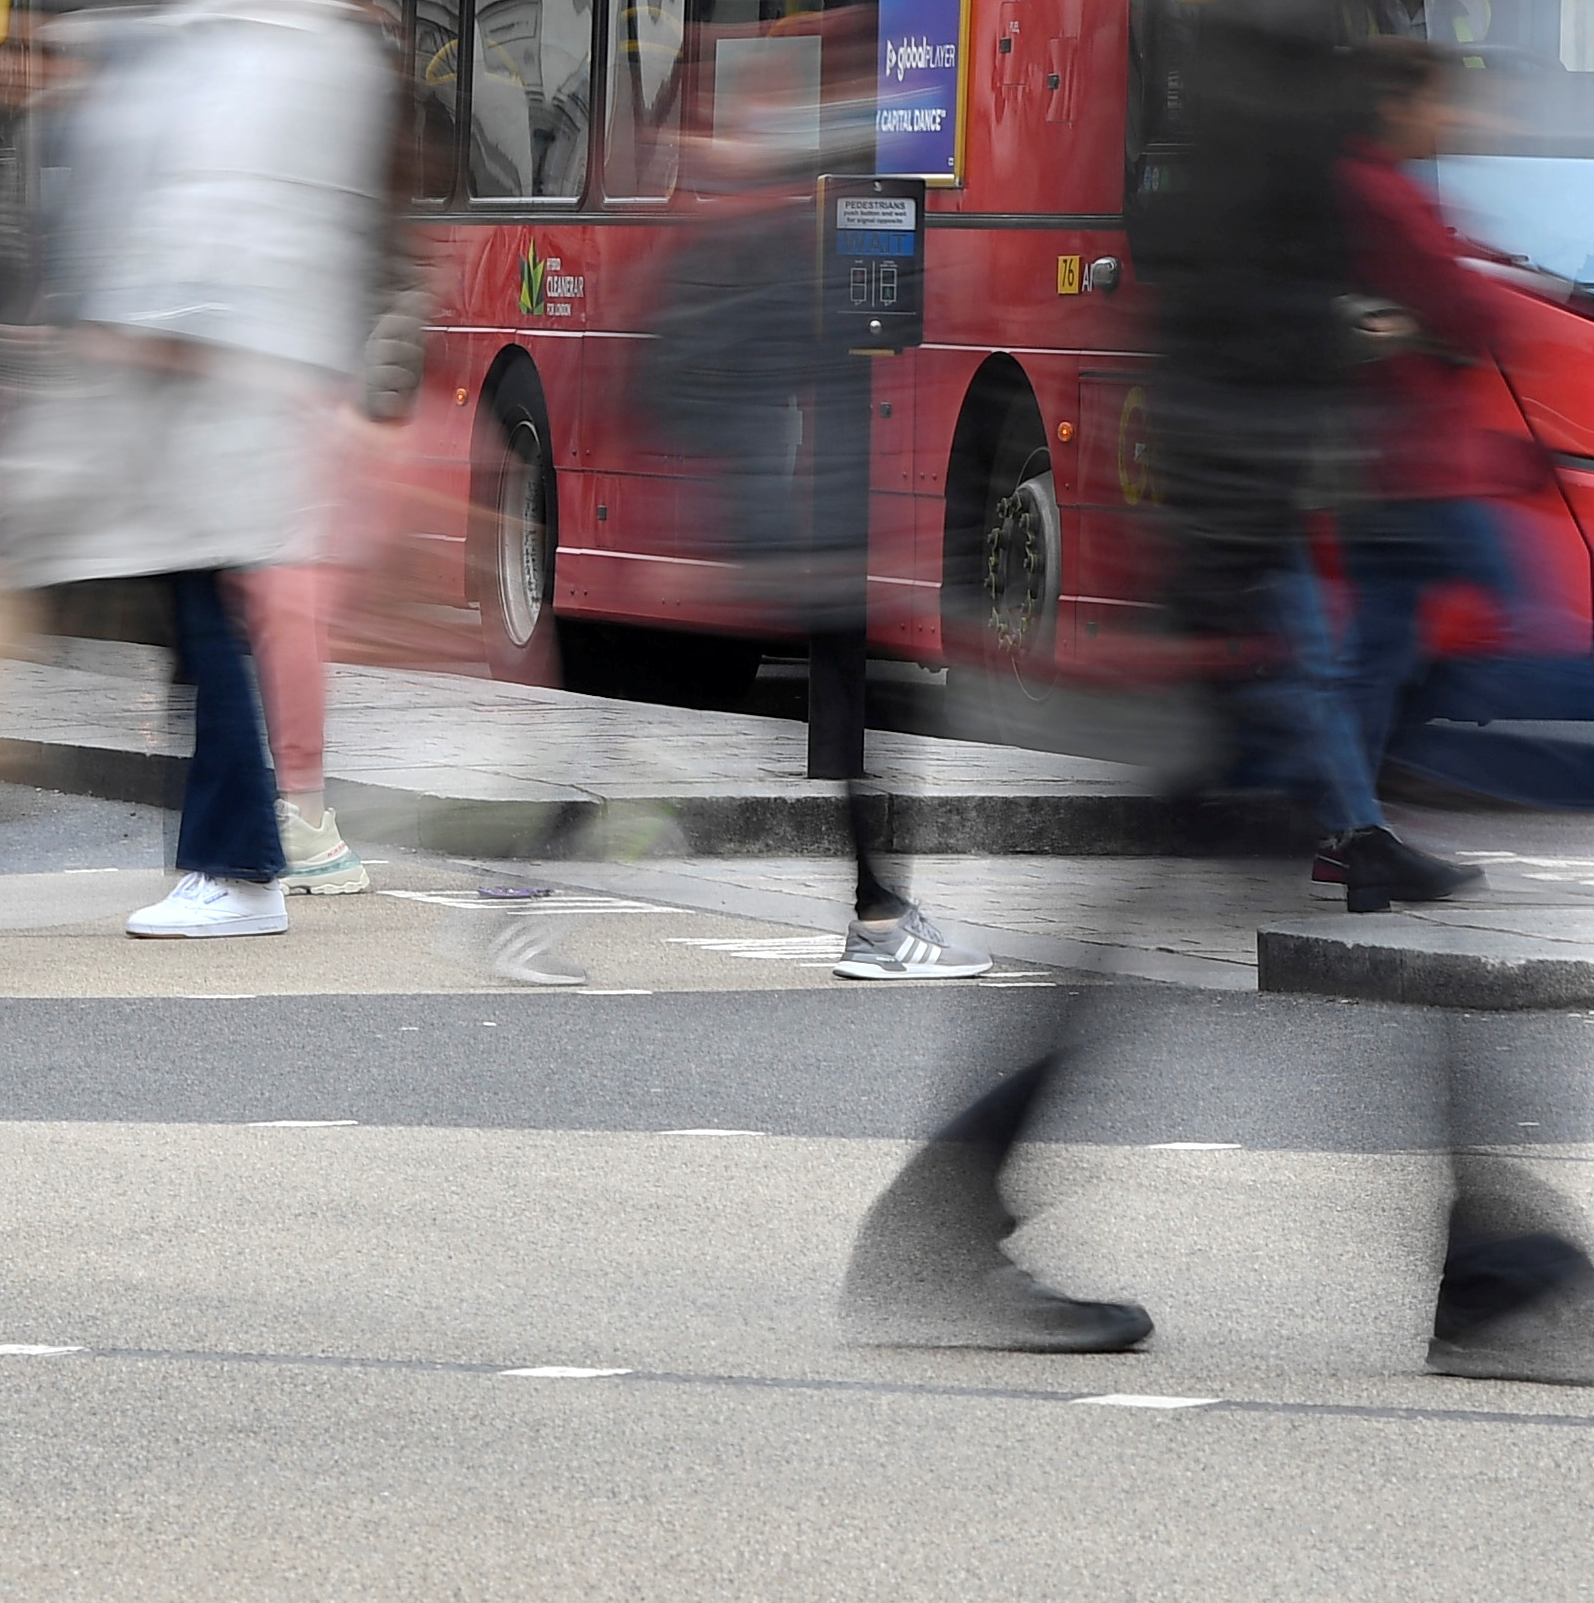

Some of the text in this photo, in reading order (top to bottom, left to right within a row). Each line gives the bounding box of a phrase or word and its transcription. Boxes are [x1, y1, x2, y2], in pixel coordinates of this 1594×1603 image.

[881, 109, 913, 132] CAPITAL
[845, 201, 906, 209] PEDESTRIANS
[1062, 258, 1075, 287] 76
